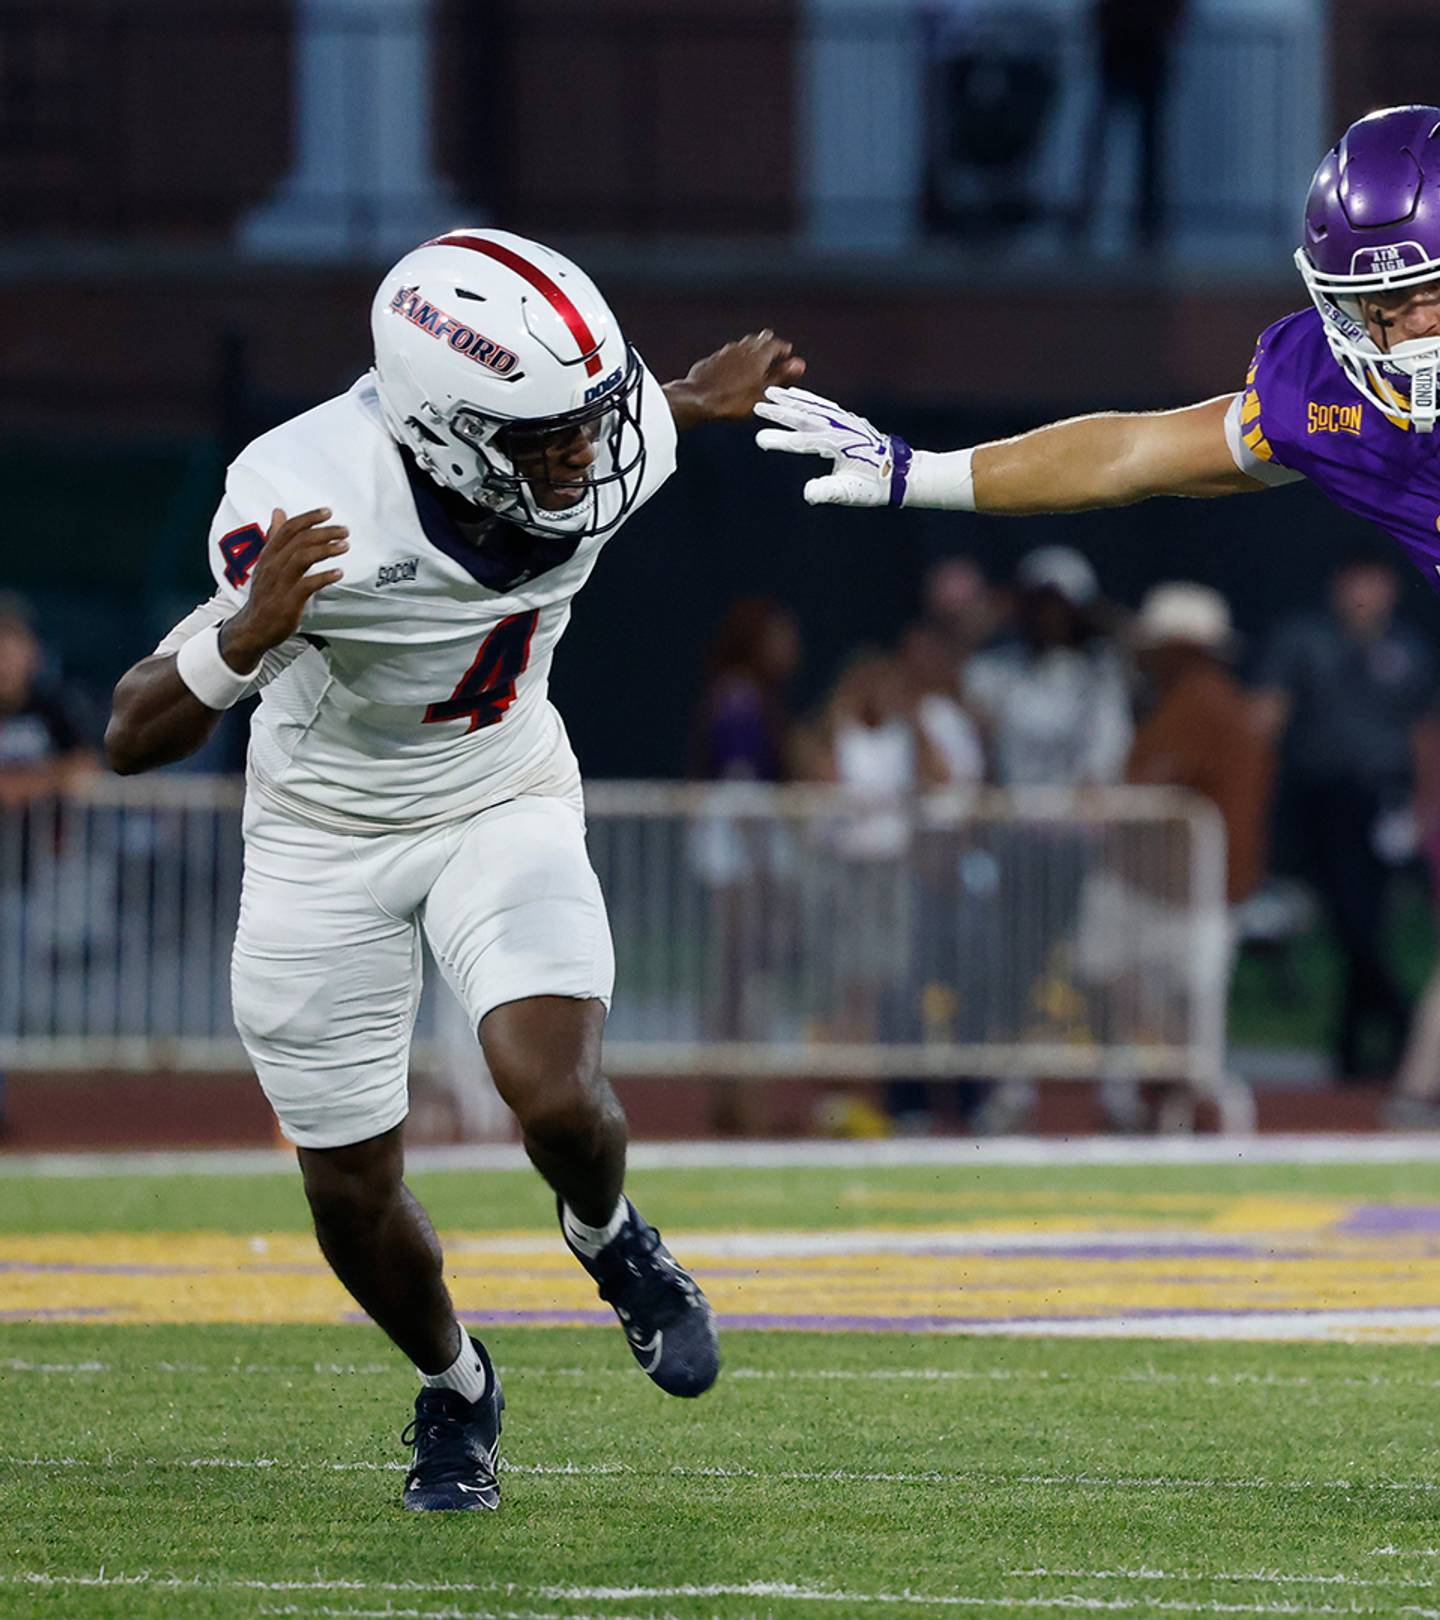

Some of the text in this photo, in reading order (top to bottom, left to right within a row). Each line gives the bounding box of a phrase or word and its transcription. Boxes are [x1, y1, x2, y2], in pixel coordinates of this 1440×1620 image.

[1371, 259, 1405, 273] HIGH
[1374, 249, 1399, 262] AIM
[390, 285, 520, 375] SAMFORD
[421, 607, 540, 735] 4
